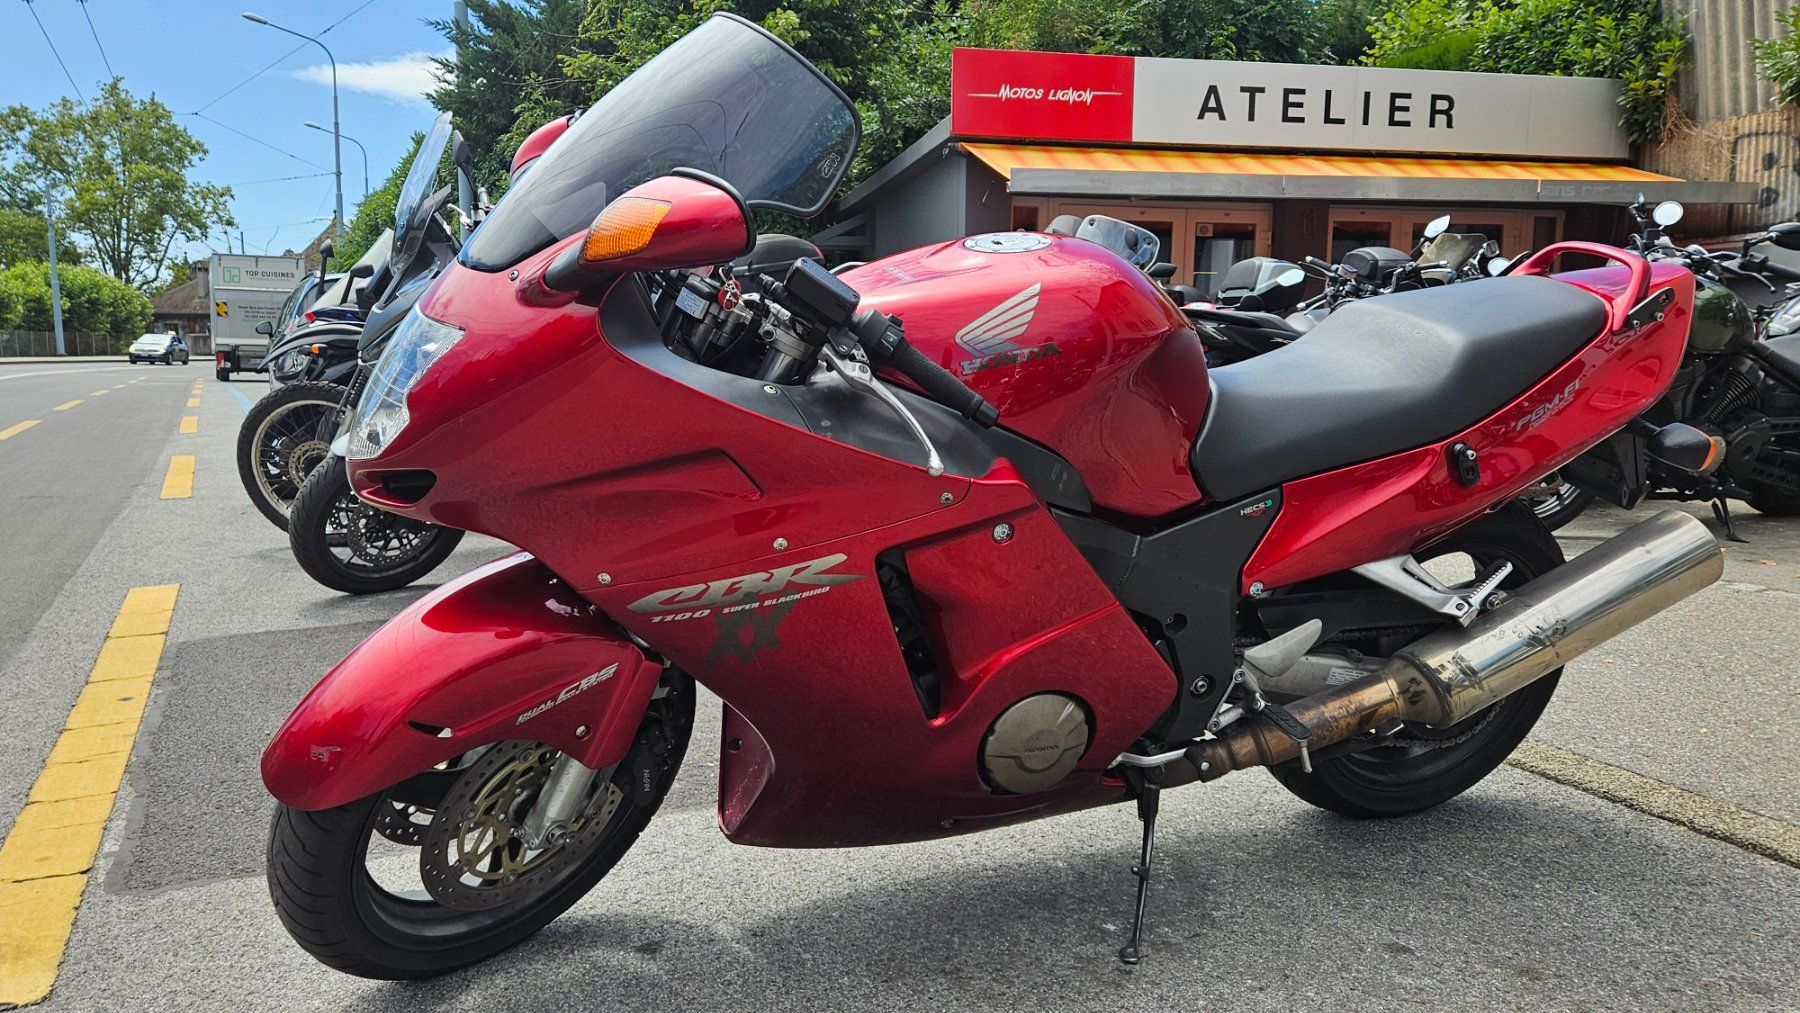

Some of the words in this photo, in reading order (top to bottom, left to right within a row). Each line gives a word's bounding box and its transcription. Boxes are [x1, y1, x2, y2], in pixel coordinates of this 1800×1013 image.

[998, 83, 1044, 102] MOTOS
[1048, 86, 1094, 106] LIGNON
[1196, 84, 1455, 129] ATELIER
[960, 342, 1062, 376] HONDA
[626, 552, 867, 614] CBR
[650, 609, 711, 623] 1100
[722, 601, 760, 614] SUPER
[763, 585, 831, 606] BLACKBIRD
[702, 589, 796, 670] XX
[516, 700, 556, 725] DUAL
[556, 662, 619, 703] CBS
